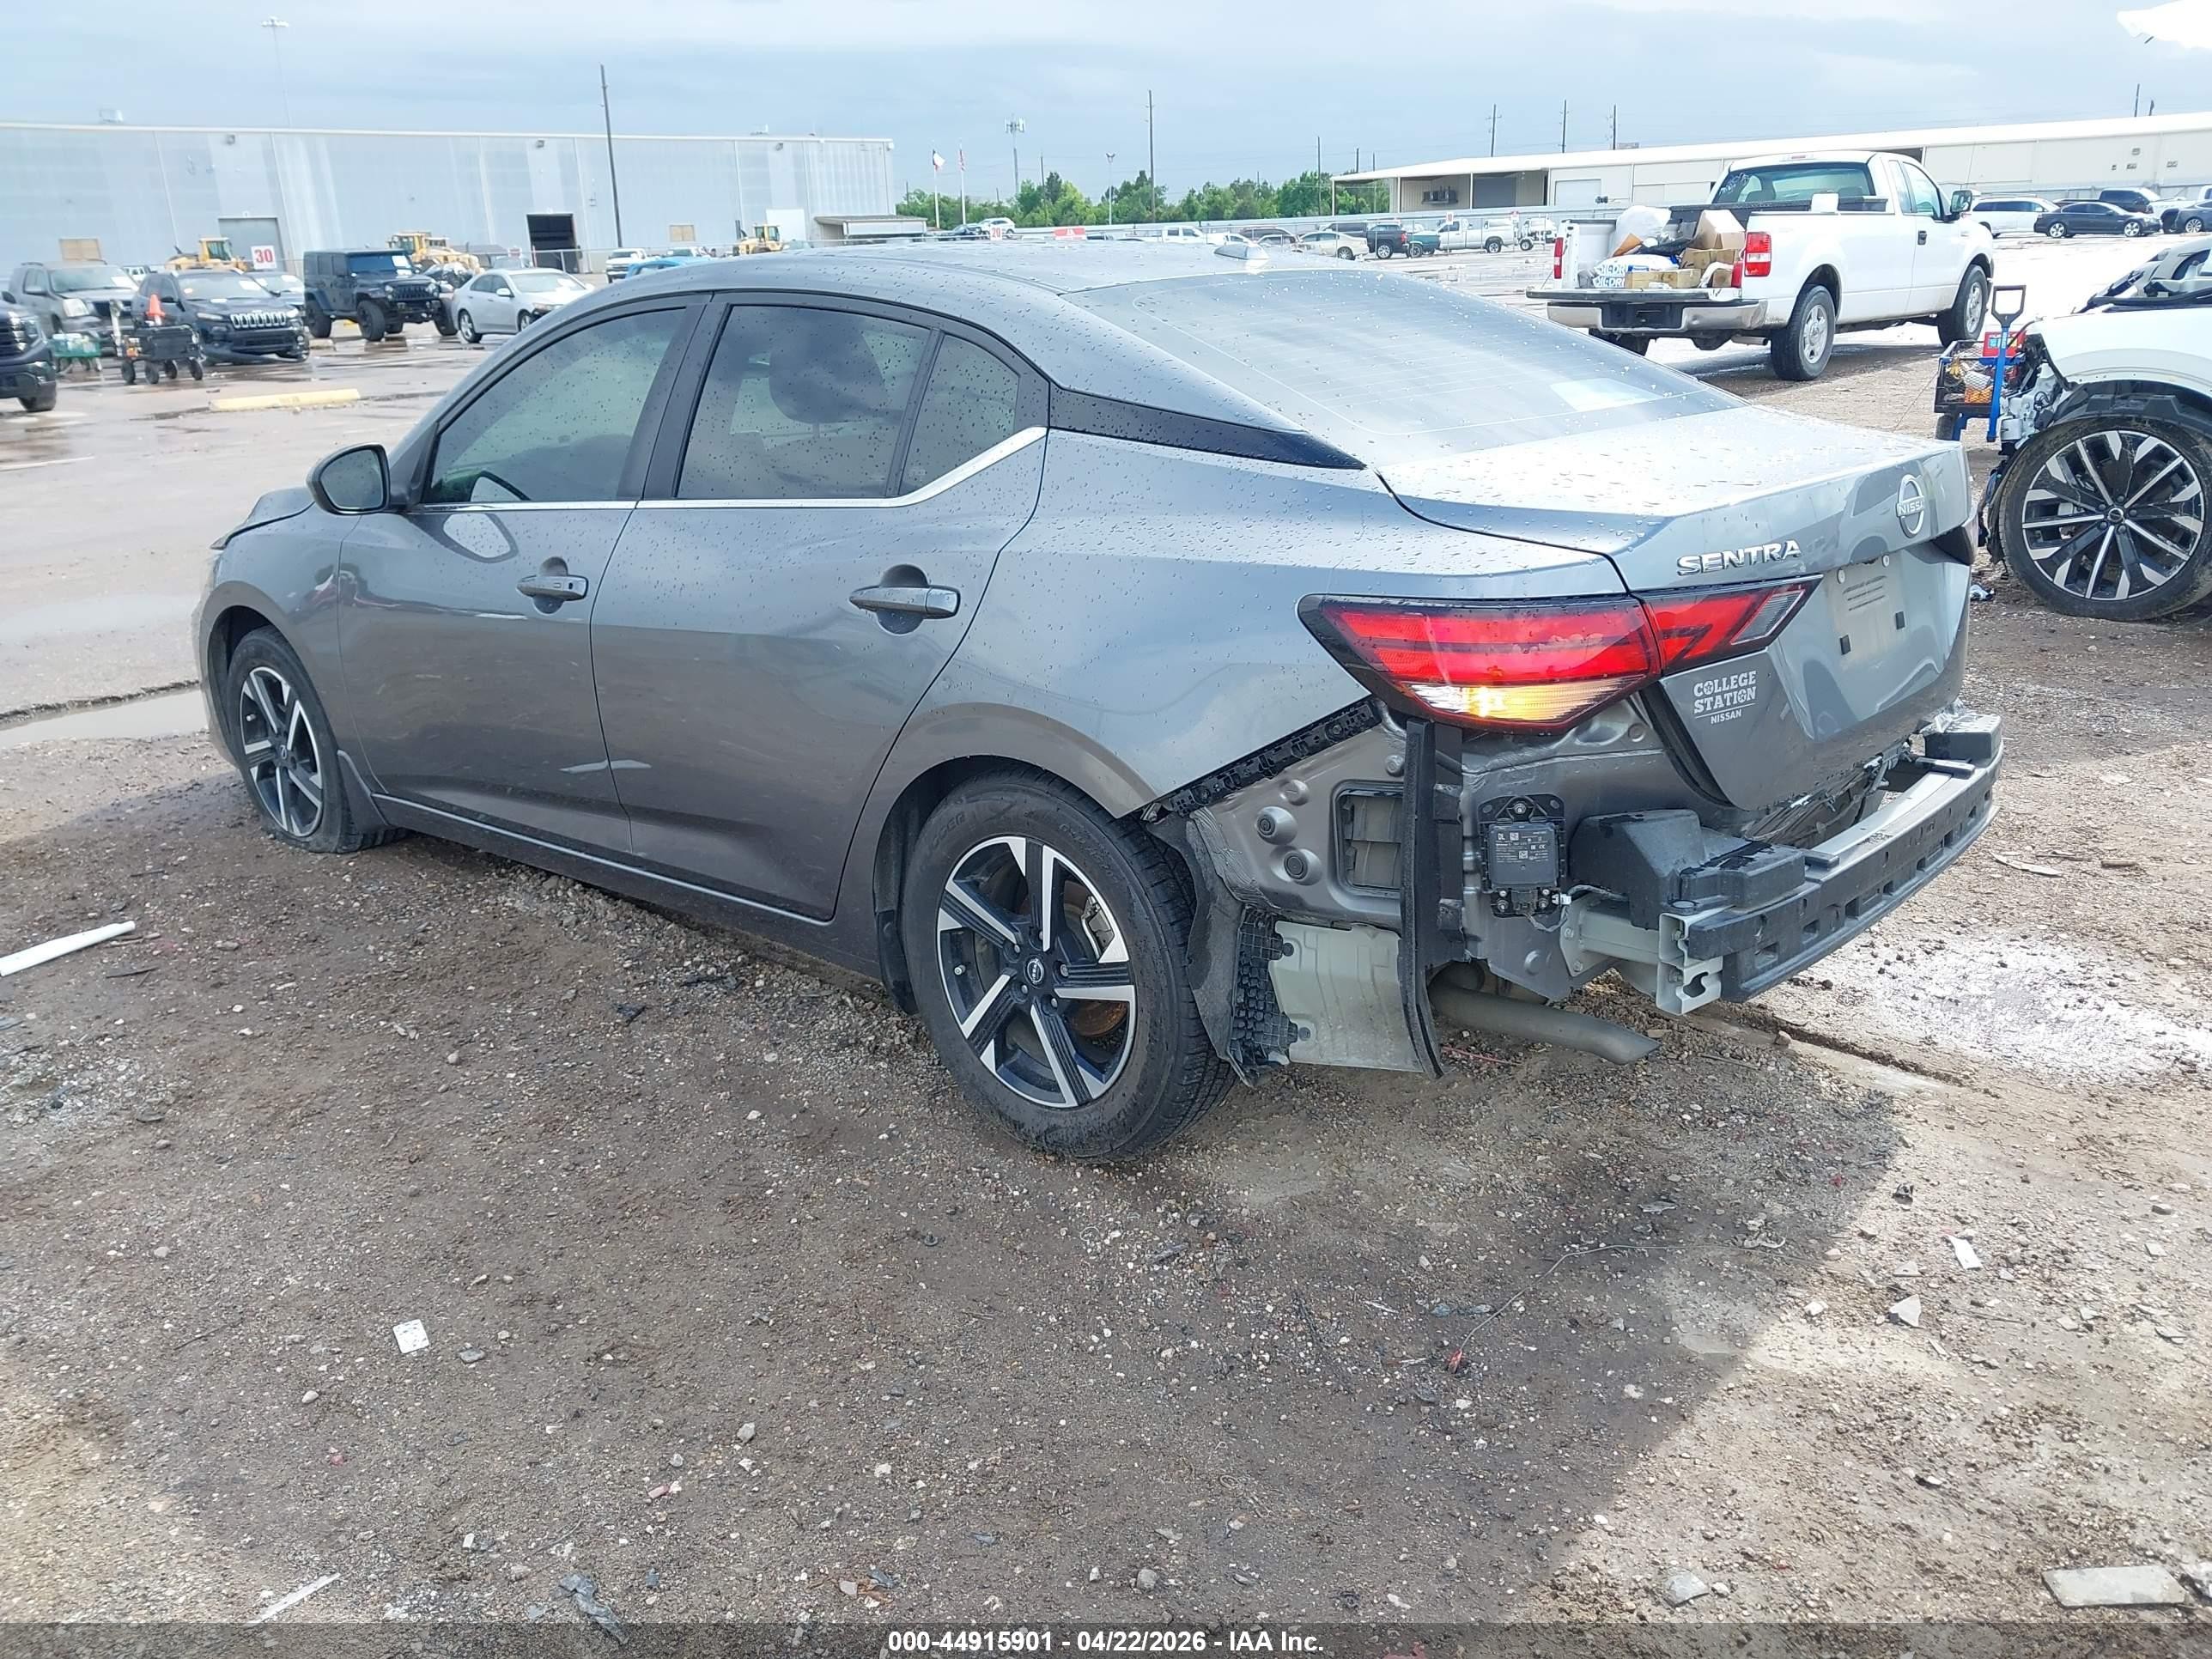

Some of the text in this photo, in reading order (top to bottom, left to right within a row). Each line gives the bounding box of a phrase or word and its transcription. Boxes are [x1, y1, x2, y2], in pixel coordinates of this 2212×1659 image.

[254, 249, 273, 263] 30
[1677, 539, 1802, 575] SENTRA
[1693, 670, 1756, 696] COLLEGE
[1693, 686, 1756, 714] STATION
[1711, 708, 1742, 724] NISSAN
